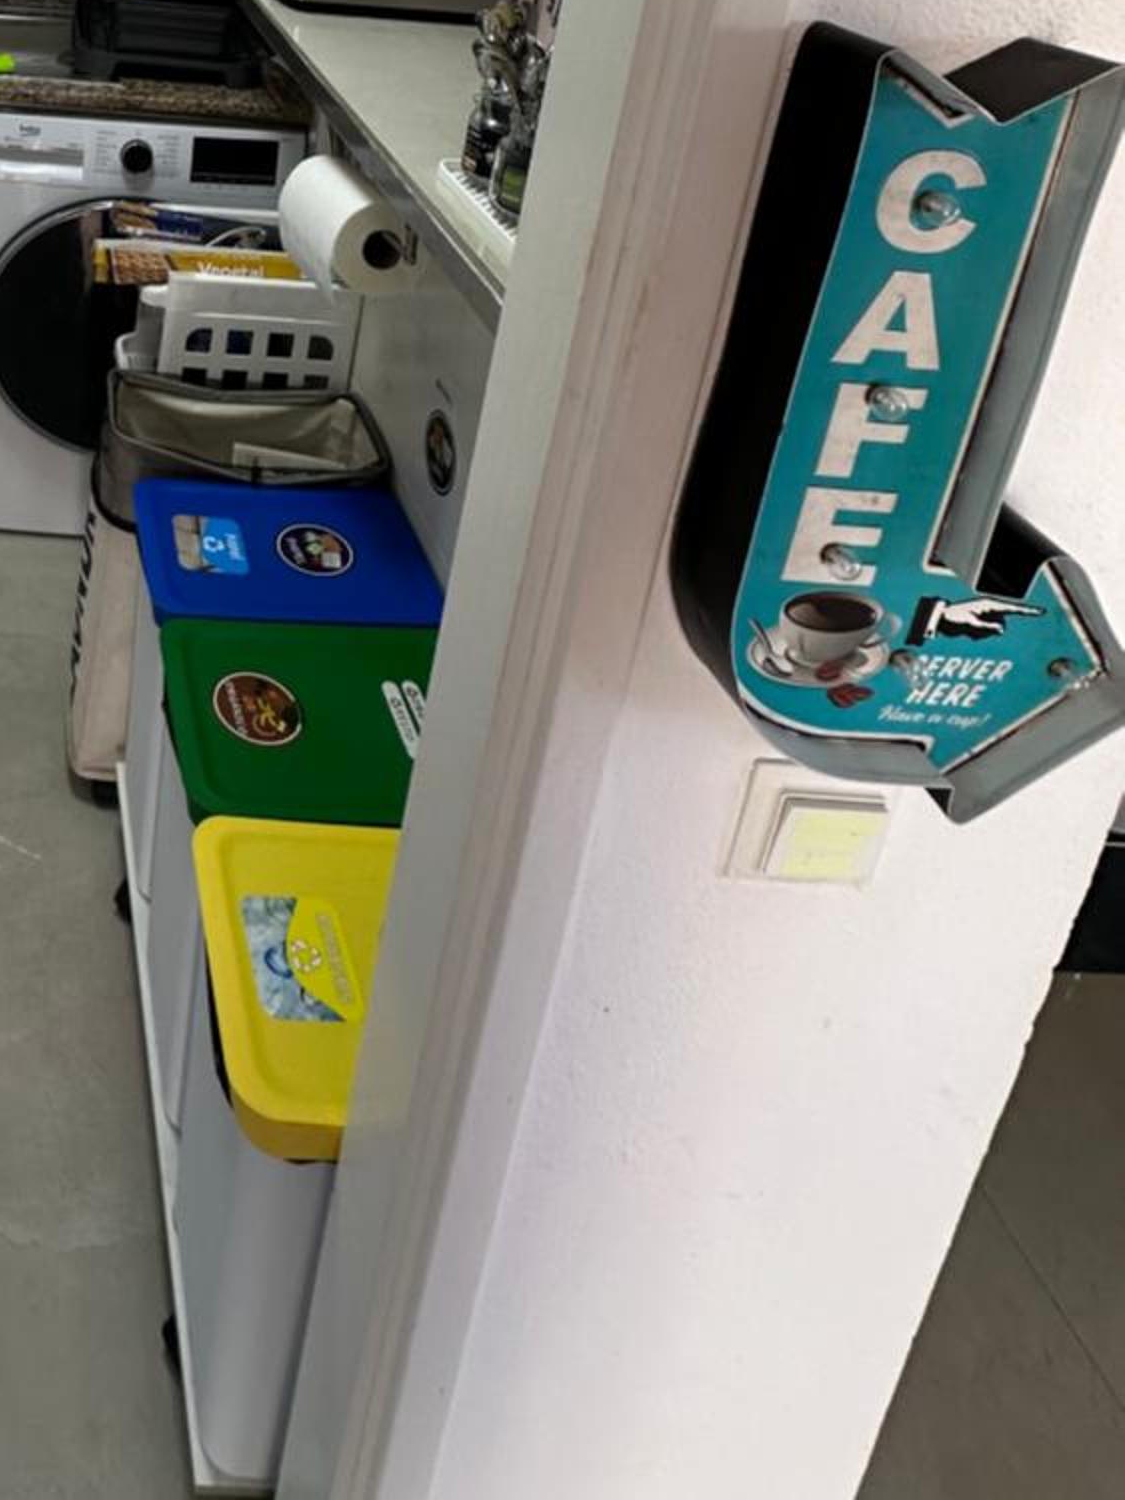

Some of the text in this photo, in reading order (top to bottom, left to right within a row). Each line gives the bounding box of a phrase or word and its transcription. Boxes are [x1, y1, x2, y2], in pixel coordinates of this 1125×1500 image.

[781, 150, 987, 588] CAFE
[913, 654, 1014, 682] SERVER
[906, 680, 987, 707] HERE
[877, 704, 926, 722] Have
[926, 713, 943, 724] a
